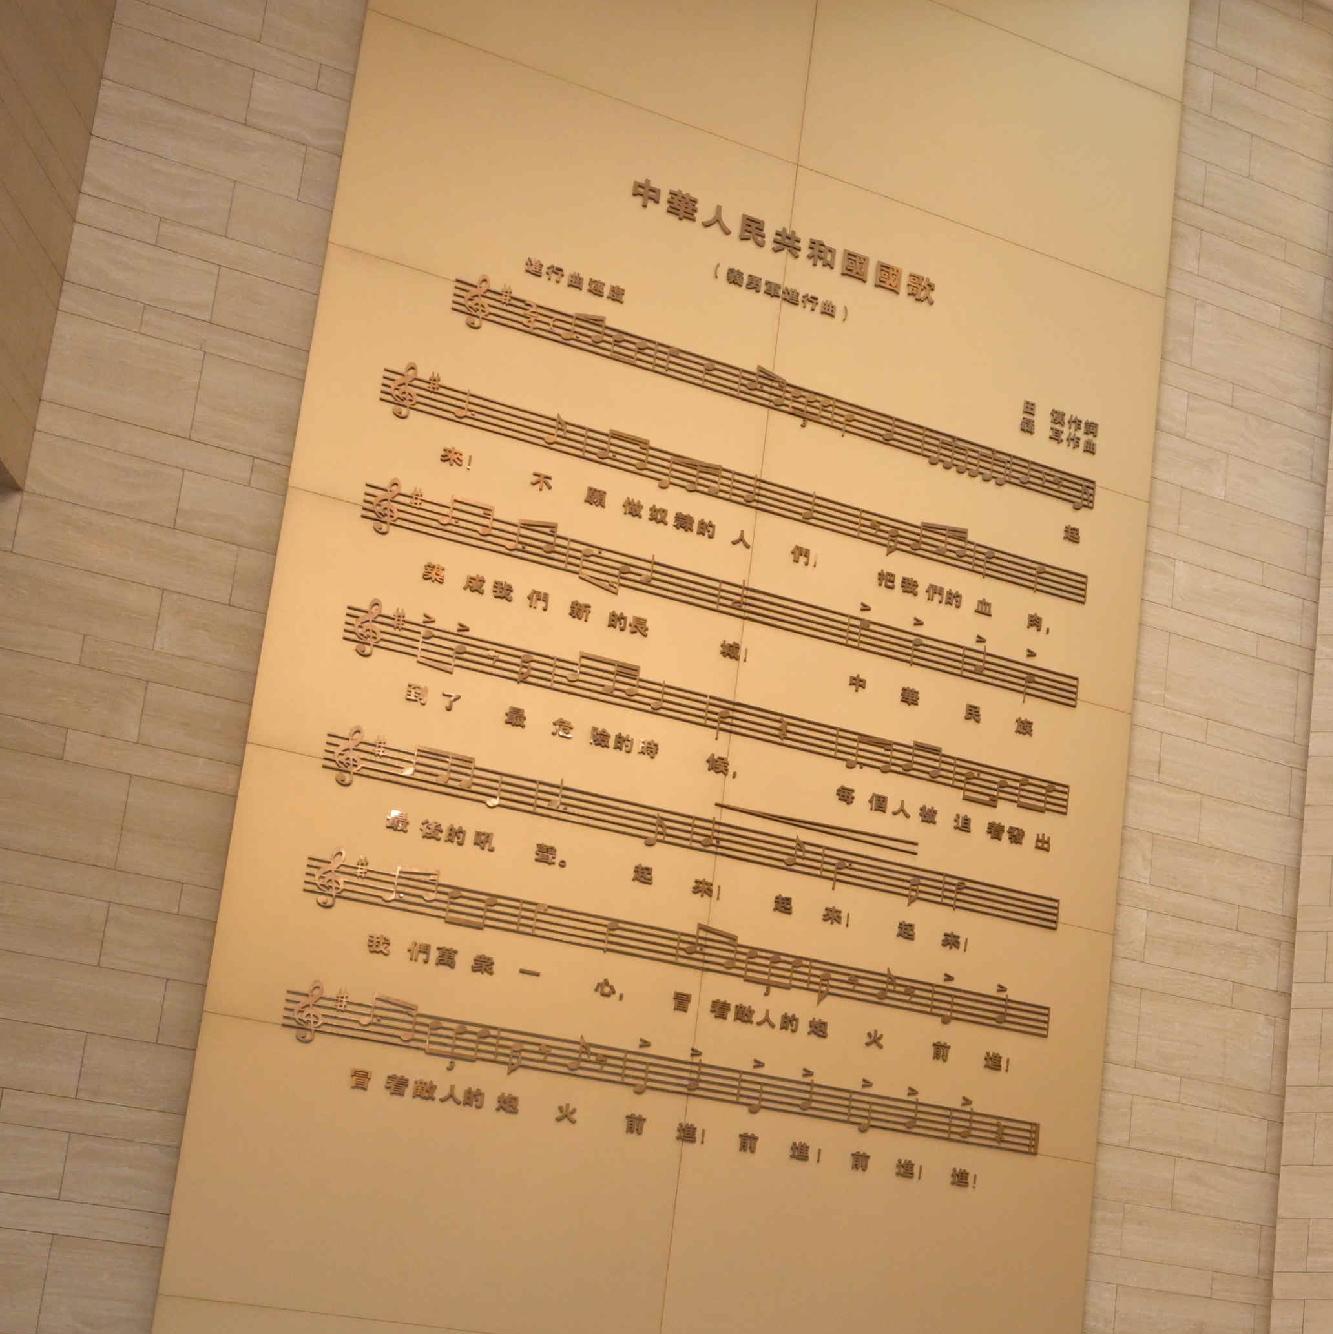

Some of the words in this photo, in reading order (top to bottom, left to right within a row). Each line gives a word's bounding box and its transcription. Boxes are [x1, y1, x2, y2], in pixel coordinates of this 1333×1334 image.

[525, 257, 625, 304] 進行曲速度
[632, 178, 935, 305] 中華人民共和國國歌
